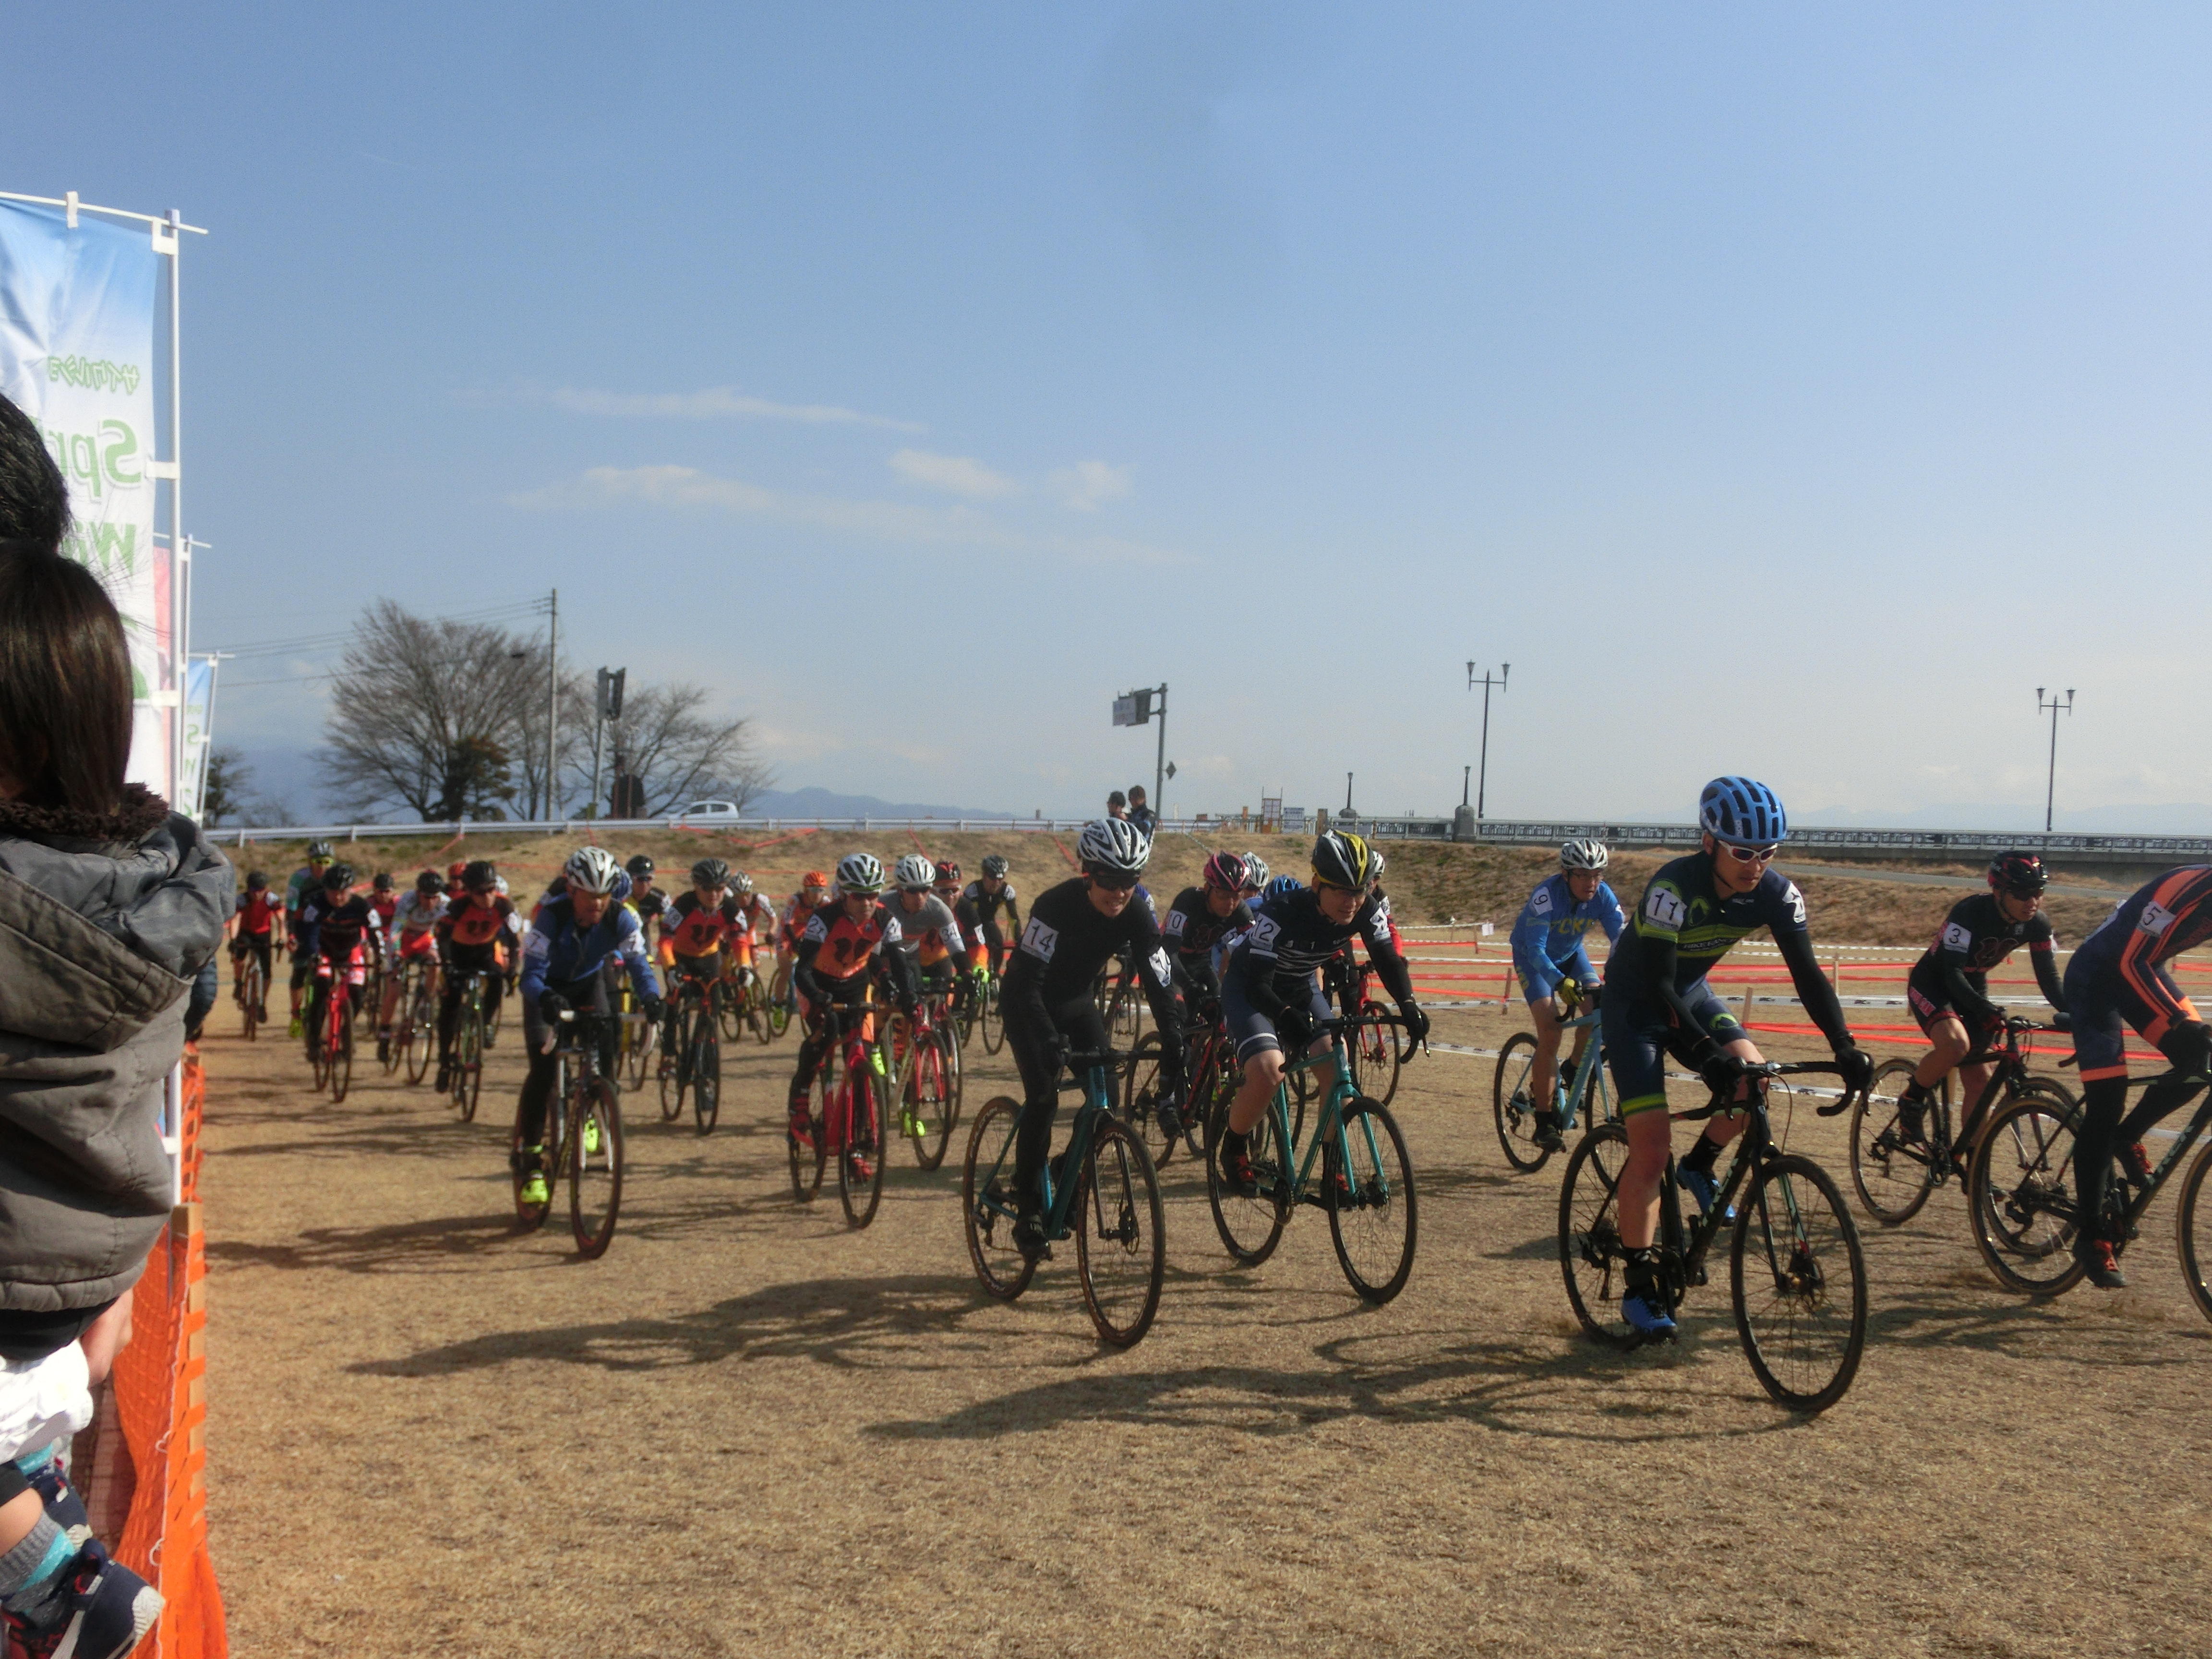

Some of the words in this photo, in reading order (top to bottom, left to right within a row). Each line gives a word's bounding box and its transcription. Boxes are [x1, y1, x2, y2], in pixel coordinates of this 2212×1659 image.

[1533, 894, 1548, 905] 9
[1654, 892, 1678, 921] 11
[1167, 914, 1182, 929] 10
[2142, 905, 2163, 926] 5
[1030, 925, 1054, 952] 14
[1253, 917, 1274, 941] 12
[1948, 928, 1961, 944] 3
